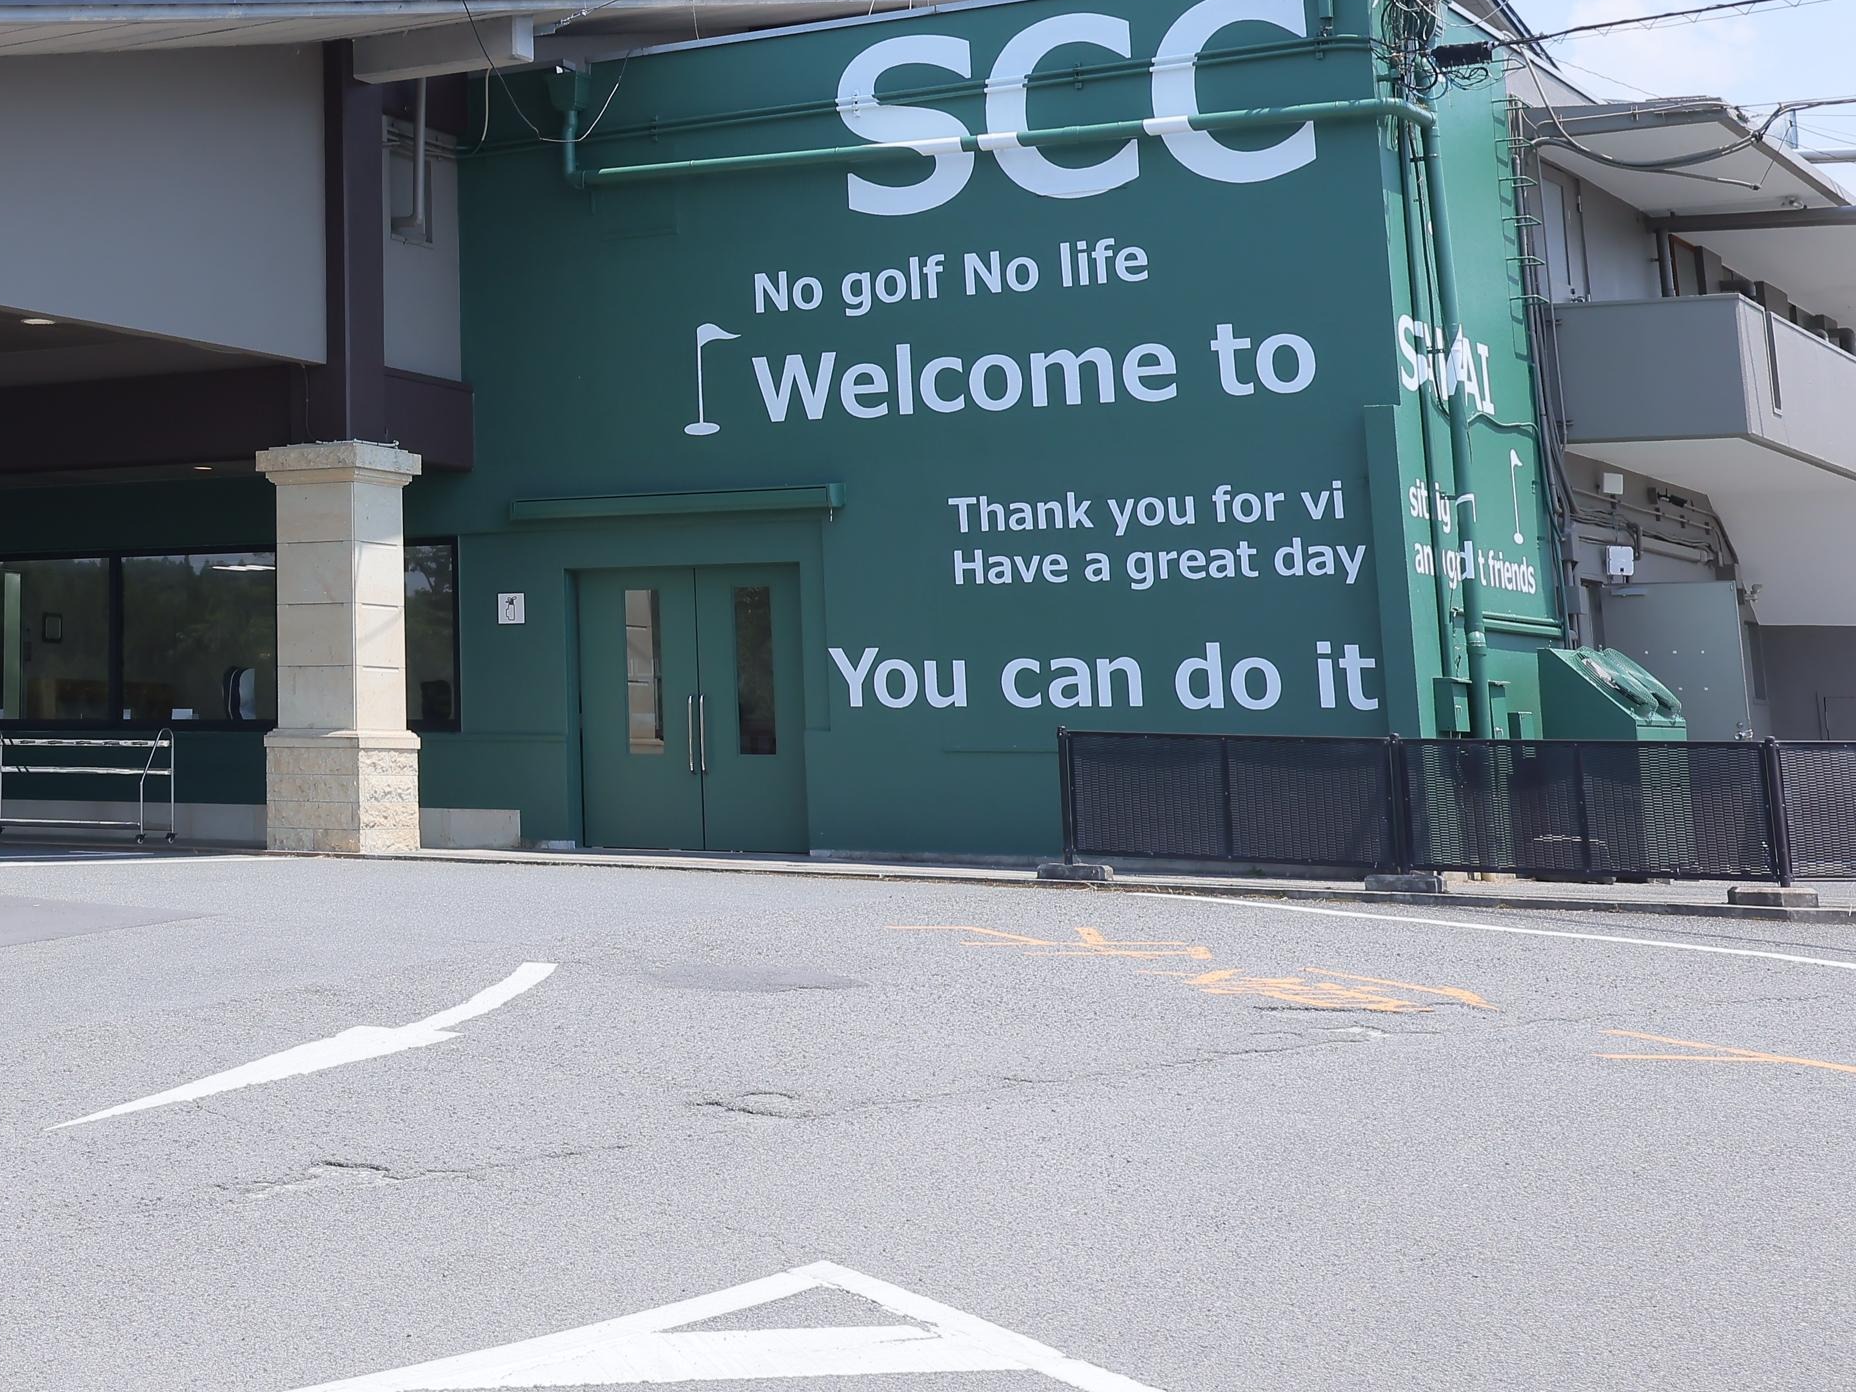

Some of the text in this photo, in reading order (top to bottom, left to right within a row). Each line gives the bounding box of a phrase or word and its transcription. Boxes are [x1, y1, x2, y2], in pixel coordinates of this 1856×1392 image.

[754, 238, 1149, 316] No golf No life
[751, 323, 1316, 422] Welcome to
[949, 481, 1344, 536] Thank you for vi
[954, 537, 1366, 590] Have a great day
[1488, 550, 1536, 595] friends
[828, 641, 1379, 711] You can do it
